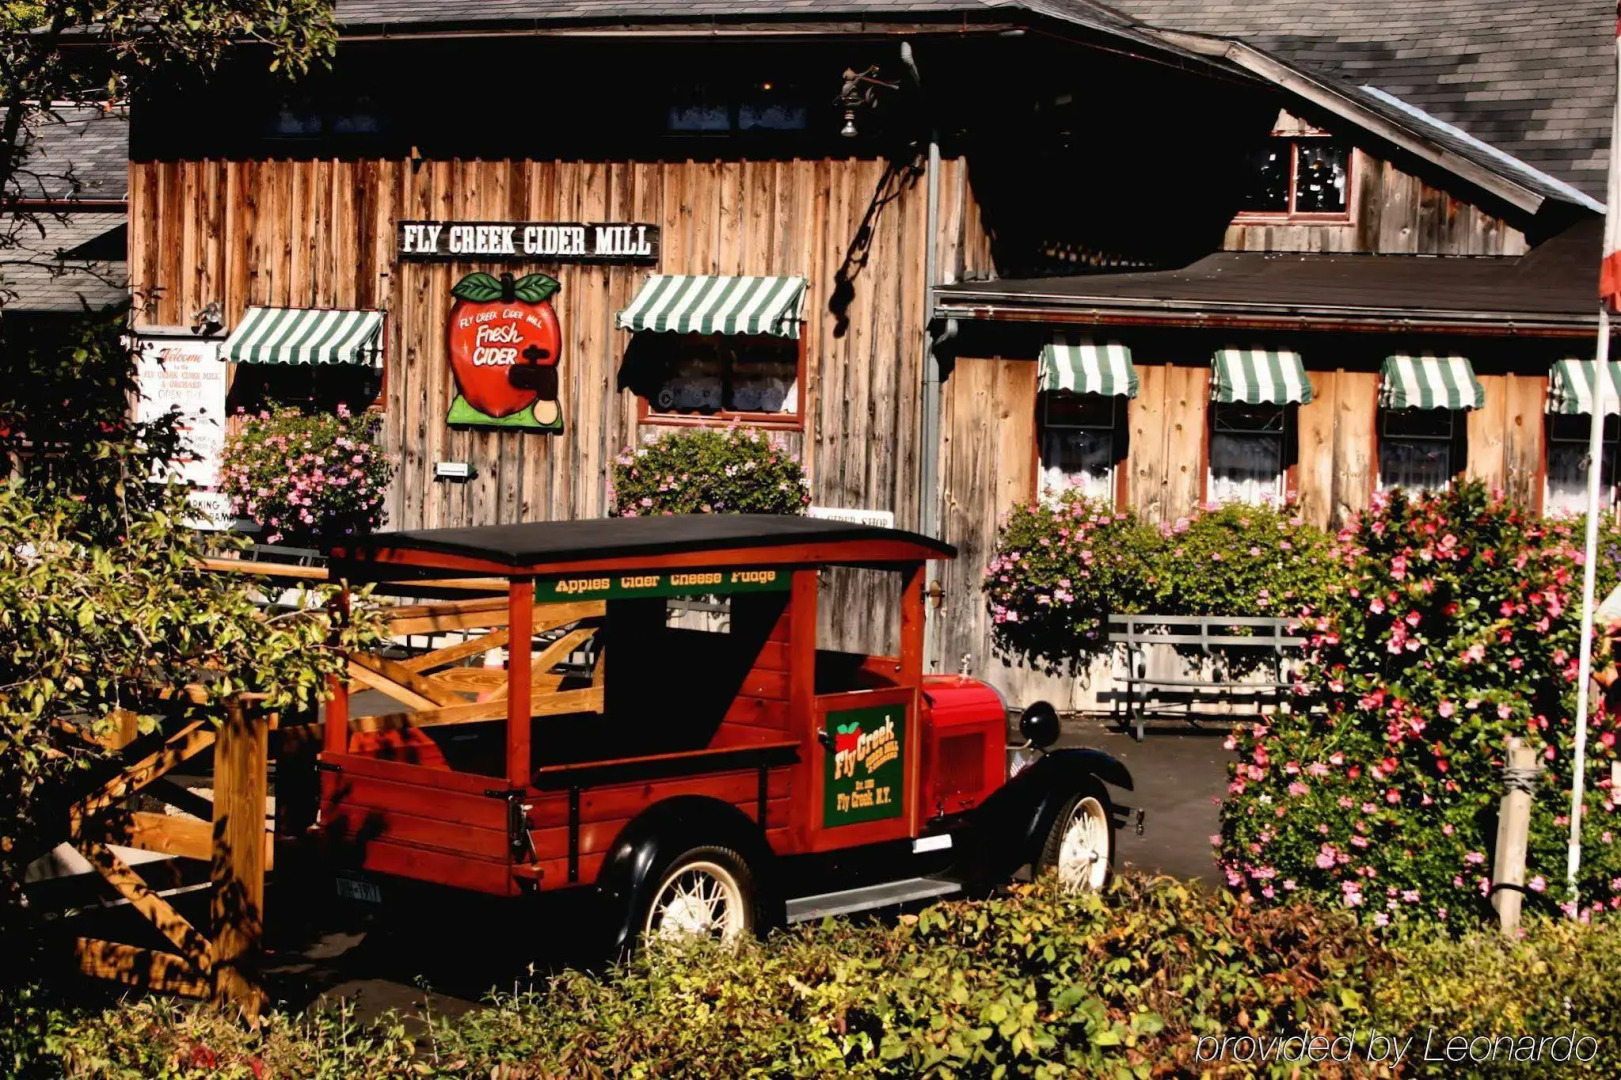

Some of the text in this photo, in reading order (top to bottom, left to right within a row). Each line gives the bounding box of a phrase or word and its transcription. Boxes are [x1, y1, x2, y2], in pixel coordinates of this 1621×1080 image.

[403, 225, 651, 256] FLY CREEK CIDER MILL
[460, 309, 542, 329] FLY CREEK CIDER MILL
[476, 322, 524, 347] Fresh
[473, 347, 518, 366] CIDER
[203, 372, 219, 380] MILL
[555, 571, 776, 594] Apples Cider Cheese Fudge
[835, 715, 894, 780] Fly Creek
[837, 794, 850, 812] Fly
[876, 787, 891, 804] N.Y.
